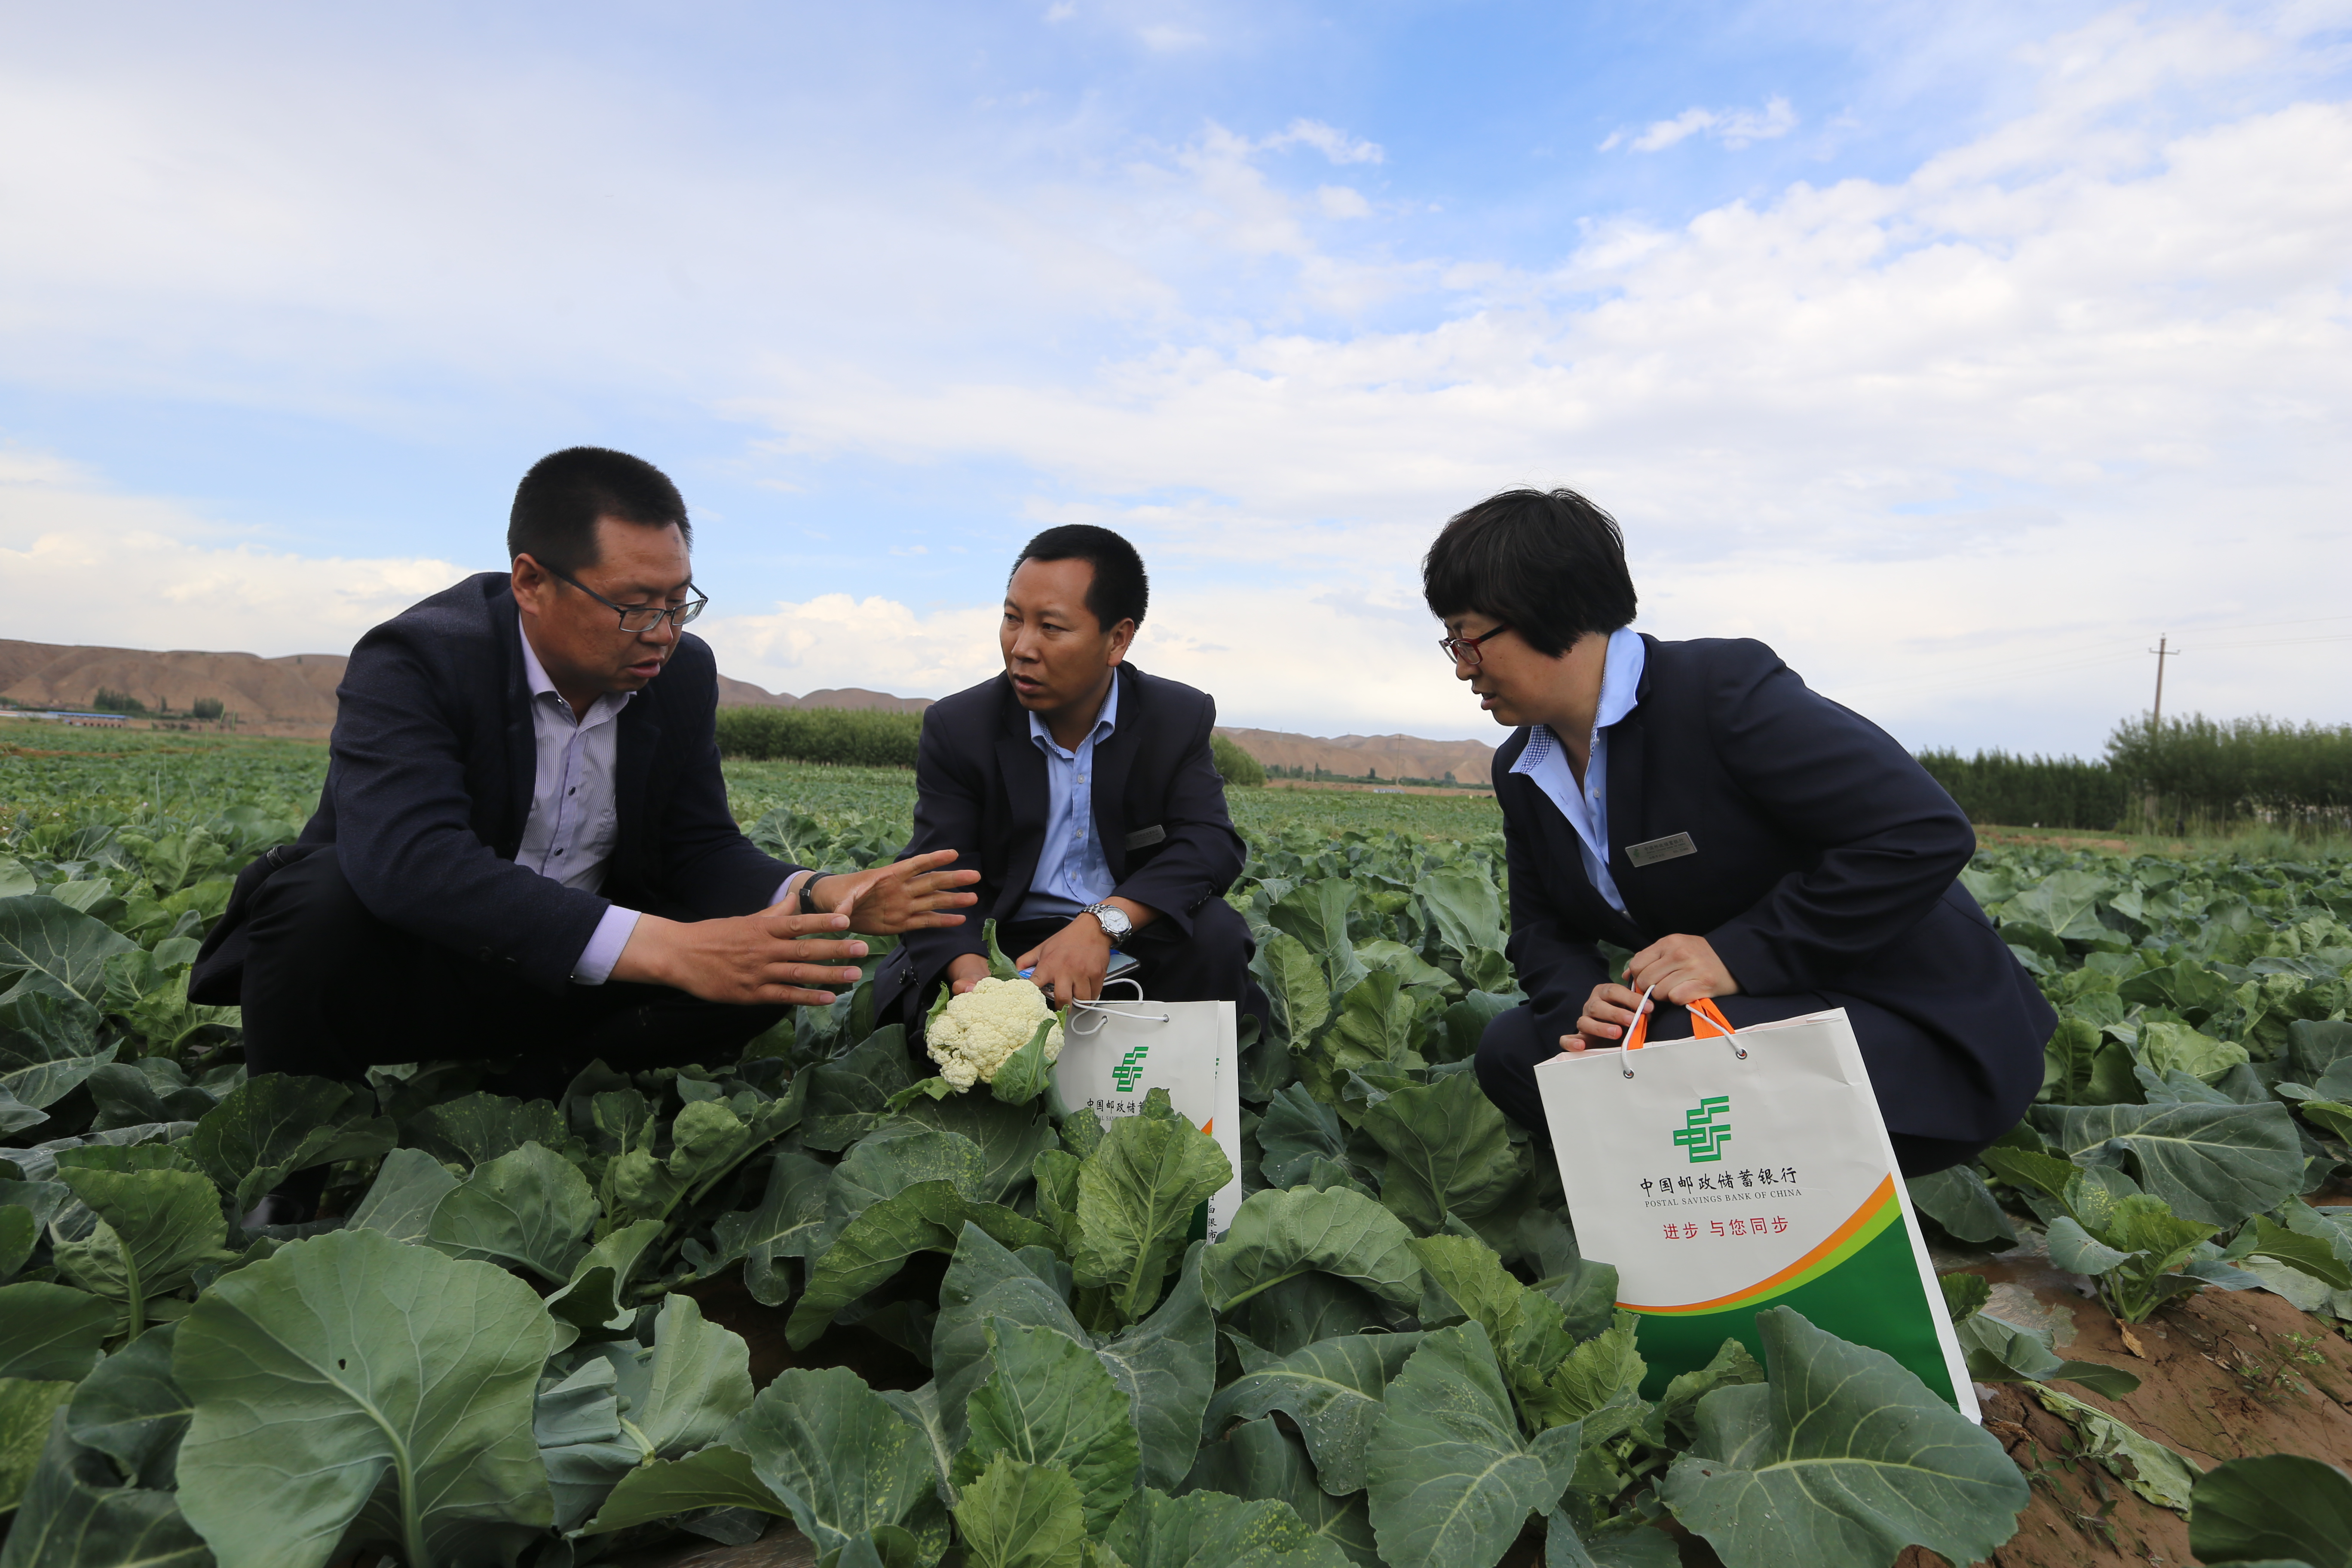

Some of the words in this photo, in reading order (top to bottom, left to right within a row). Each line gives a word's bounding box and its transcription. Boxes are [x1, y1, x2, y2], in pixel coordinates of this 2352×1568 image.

[1640, 1167, 1797, 1197] 中国邮政储蓄银行
[1645, 1199, 1678, 1207] POSTAL
[1681, 1195, 1722, 1205] SAVINGS
[1725, 1193, 1752, 1201] BANK
[1770, 1189, 1802, 1197] CHINA
[1663, 1222, 1698, 1240] 进步
[1710, 1216, 1788, 1237] 与您同步
